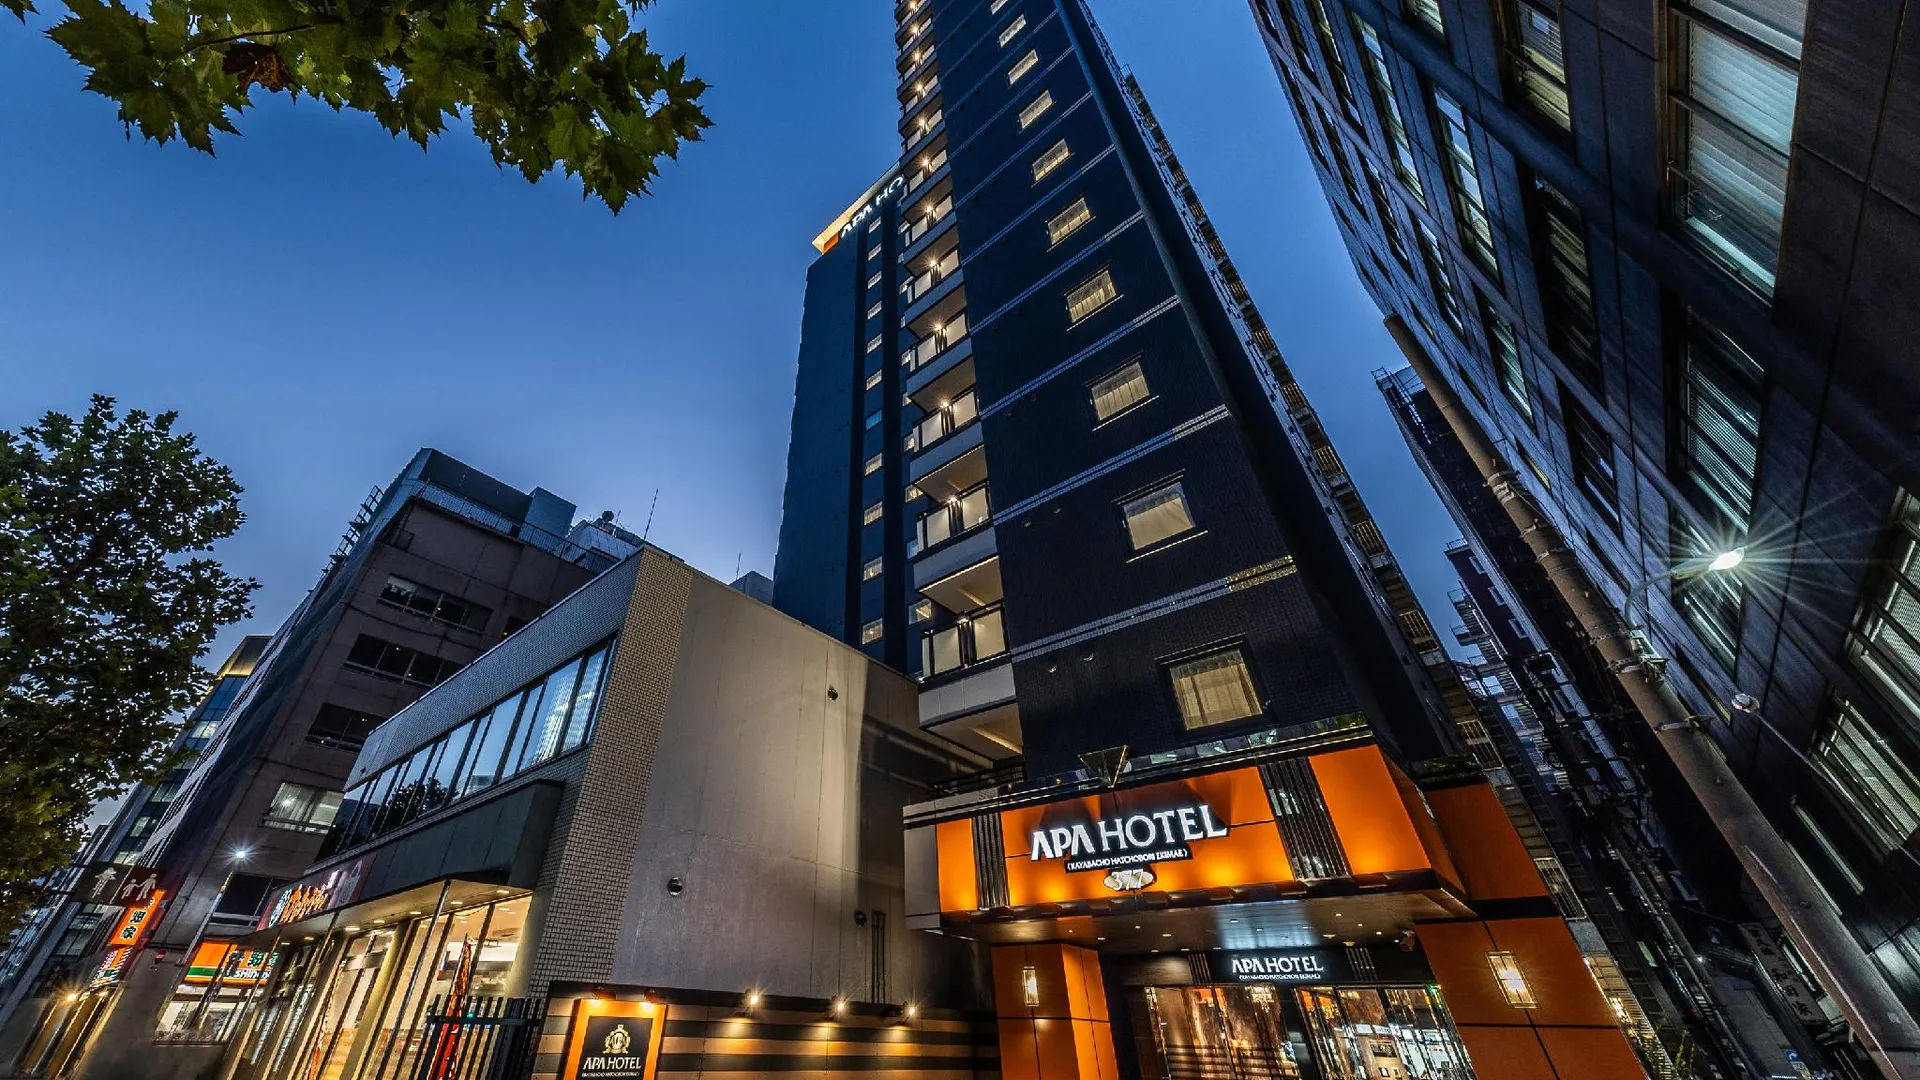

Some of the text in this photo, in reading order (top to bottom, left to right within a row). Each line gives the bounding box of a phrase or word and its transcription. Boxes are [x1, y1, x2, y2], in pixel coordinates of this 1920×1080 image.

[841, 204, 873, 238] APA
[1031, 804, 1228, 861] APA HOTEL
[1232, 955, 1324, 973] APA HOTEL
[582, 1056, 642, 1070] APA HOTEL
